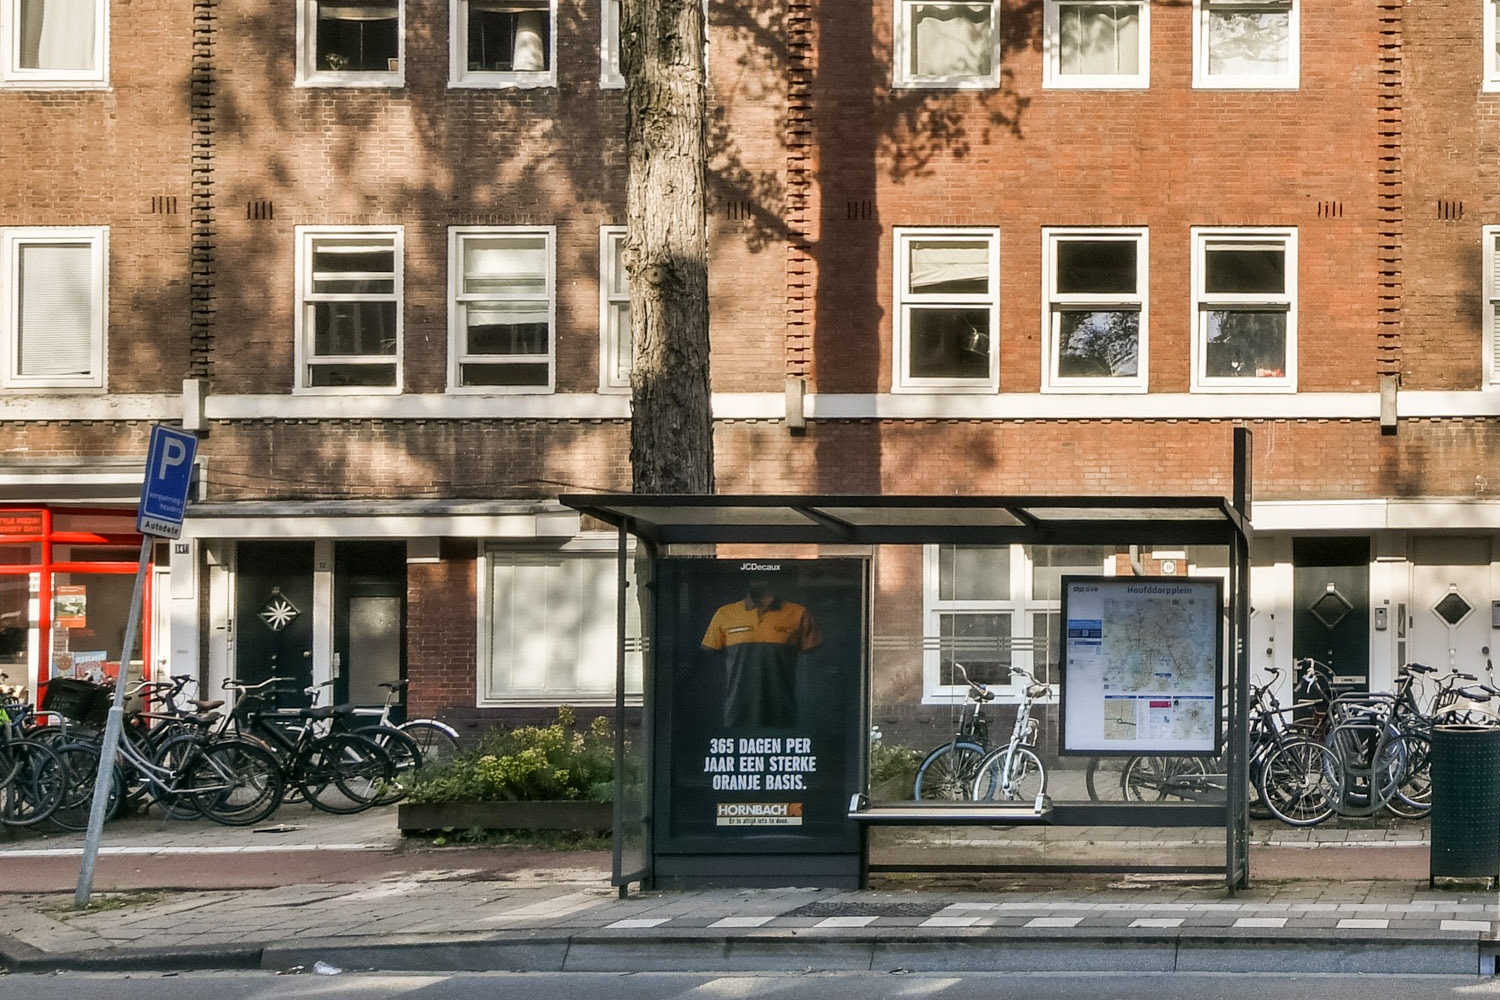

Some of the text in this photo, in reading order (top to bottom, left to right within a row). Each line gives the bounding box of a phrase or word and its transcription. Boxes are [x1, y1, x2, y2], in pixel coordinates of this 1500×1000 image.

[158, 436, 186, 480] P
[144, 520, 179, 535] Autodate
[740, 563, 781, 571] JCDecaux
[1127, 586, 1192, 595] Hoofddorpplein
[710, 738, 811, 753] 365 DAGEN PER
[704, 756, 817, 772] JAAR EEN STERKE
[713, 775, 807, 790] ORANJE BASIS.
[719, 805, 787, 815] HORNBACH
